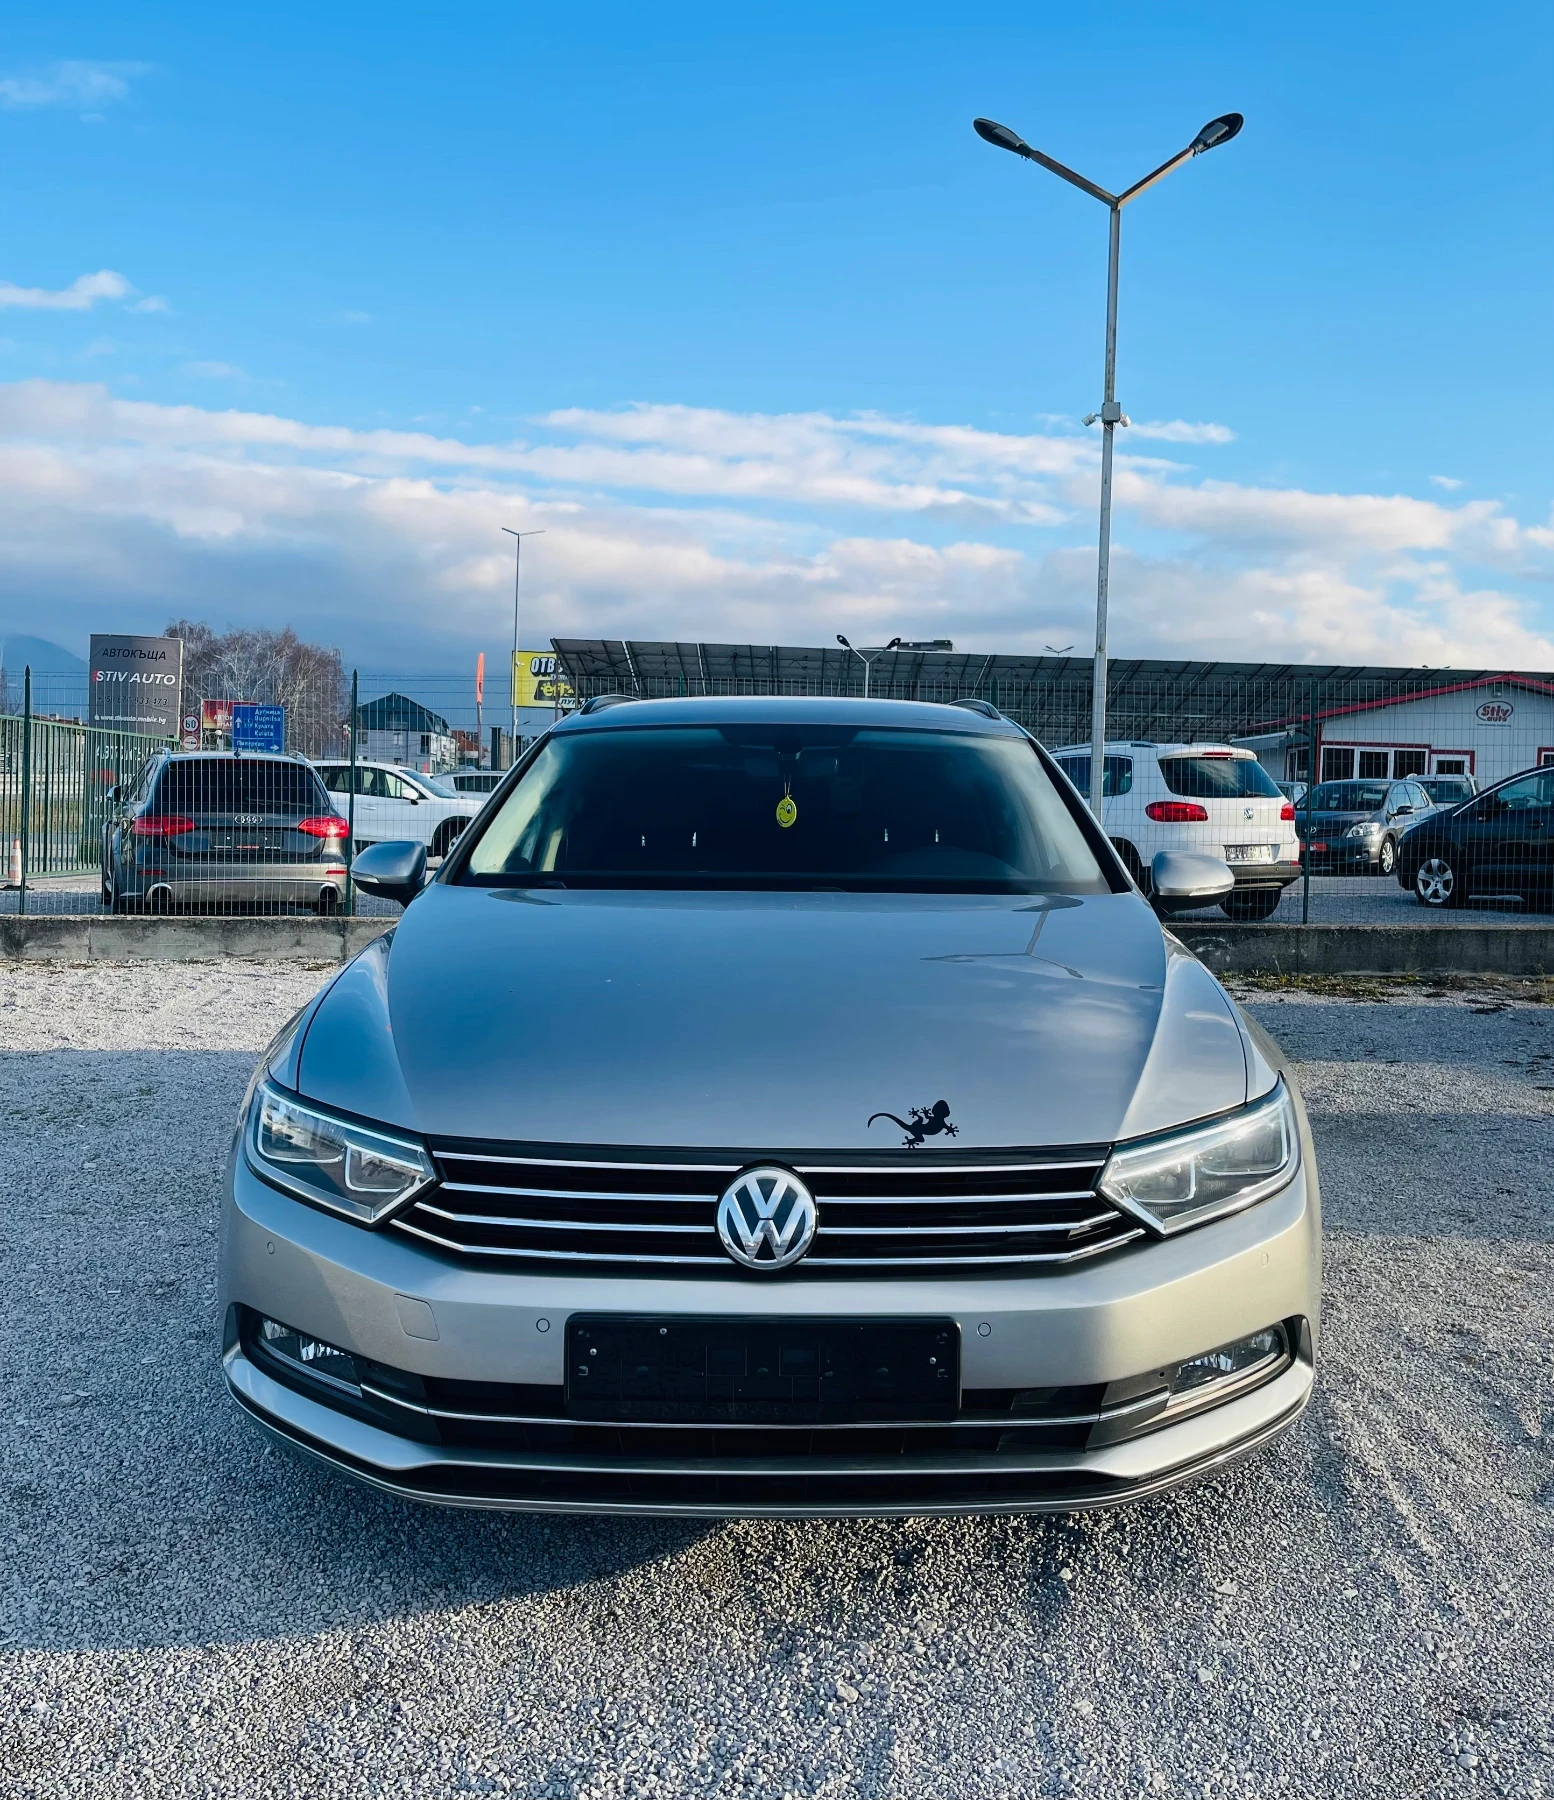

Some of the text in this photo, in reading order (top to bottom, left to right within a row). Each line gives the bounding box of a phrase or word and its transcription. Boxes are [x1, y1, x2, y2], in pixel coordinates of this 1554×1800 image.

[102, 648, 166, 661] АВТОКЪЩА
[95, 670, 176, 685] STIV AUTO
[1481, 705, 1510, 717] Stiv
